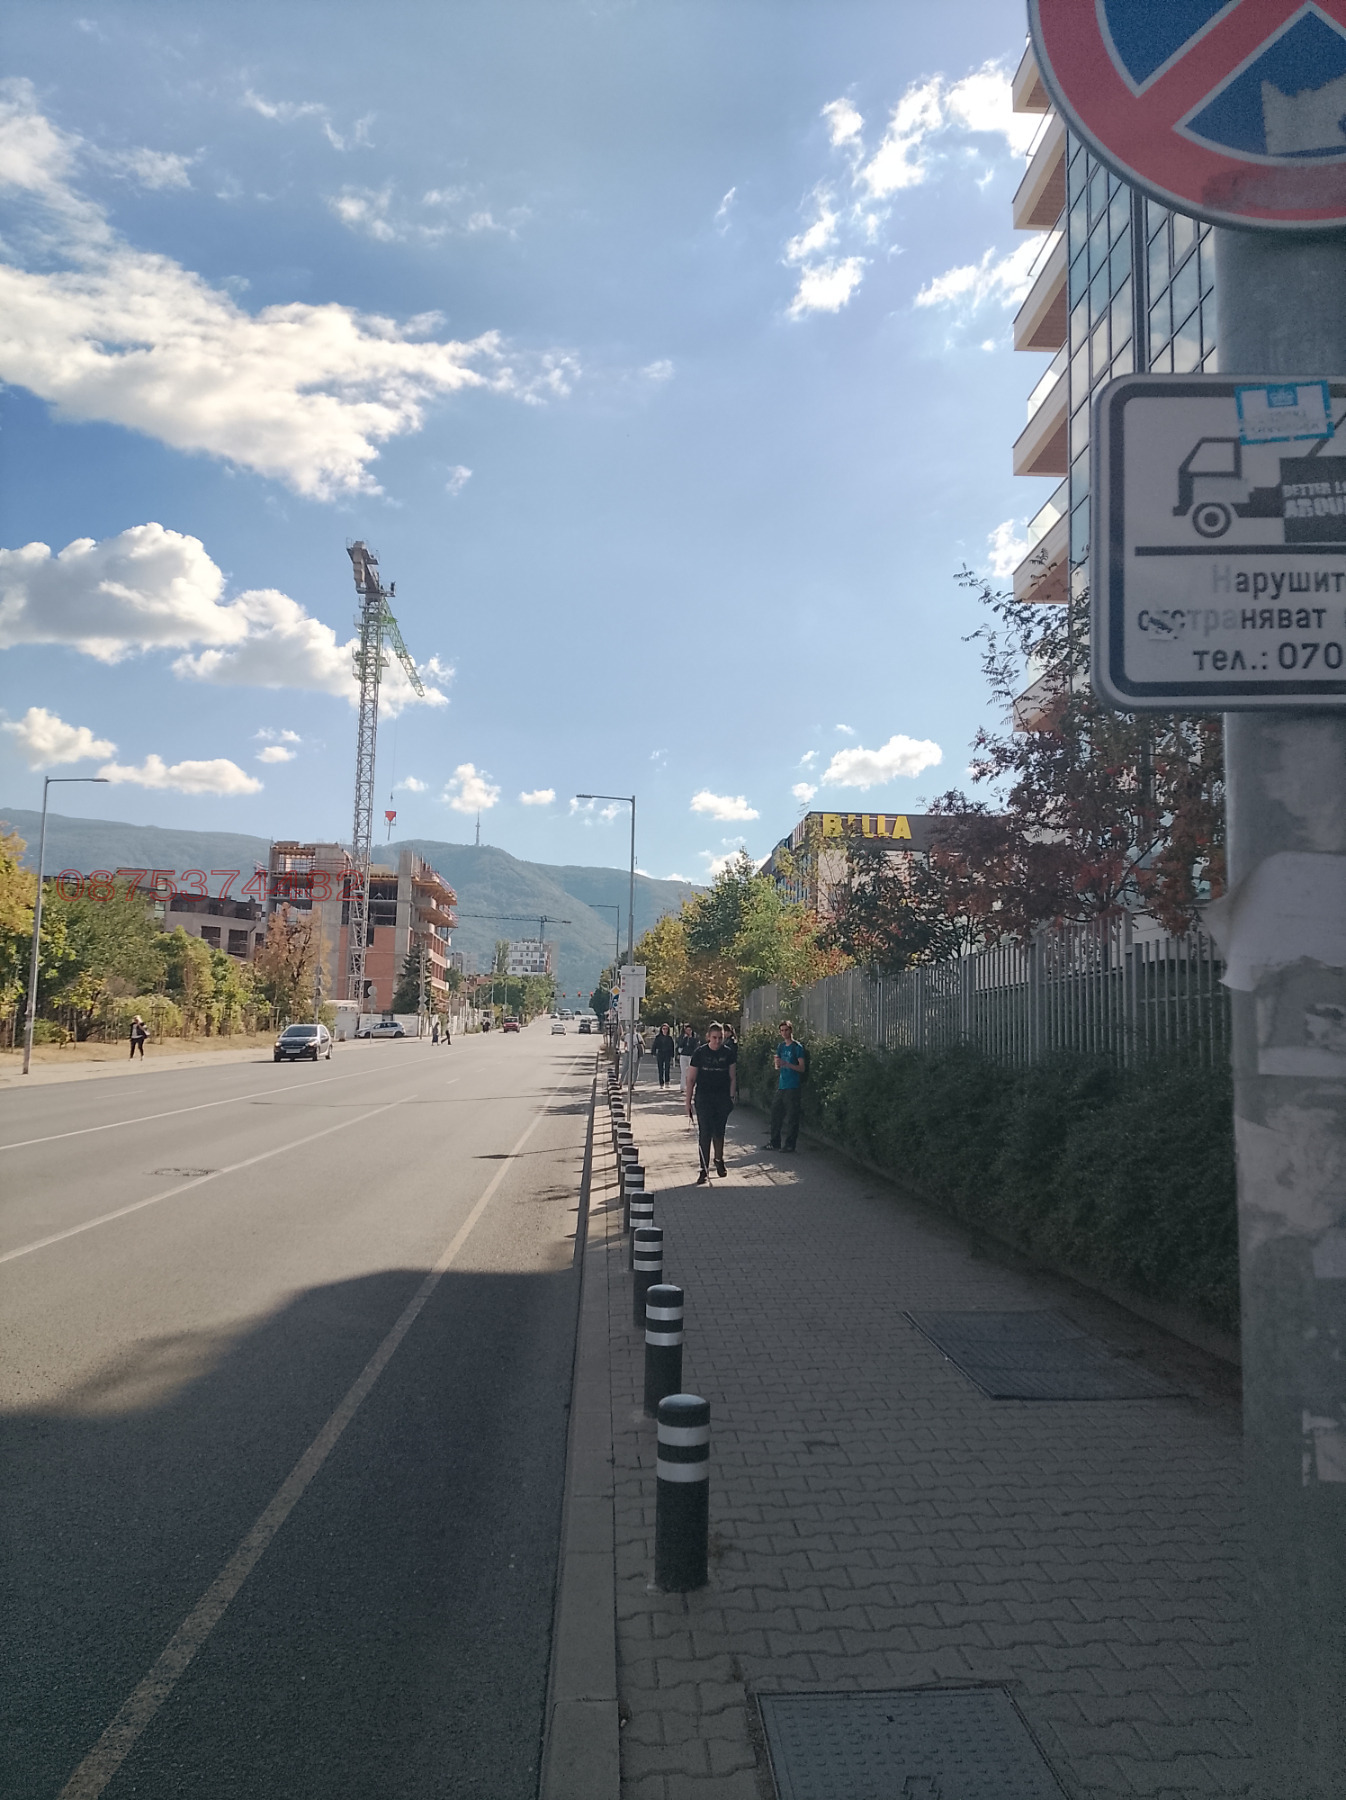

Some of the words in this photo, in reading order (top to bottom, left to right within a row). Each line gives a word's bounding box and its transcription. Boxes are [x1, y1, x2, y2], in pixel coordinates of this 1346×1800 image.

[1193, 650, 1268, 672] тел.:
[1278, 642, 1344, 670] 070
[823, 813, 912, 839] BILLA
